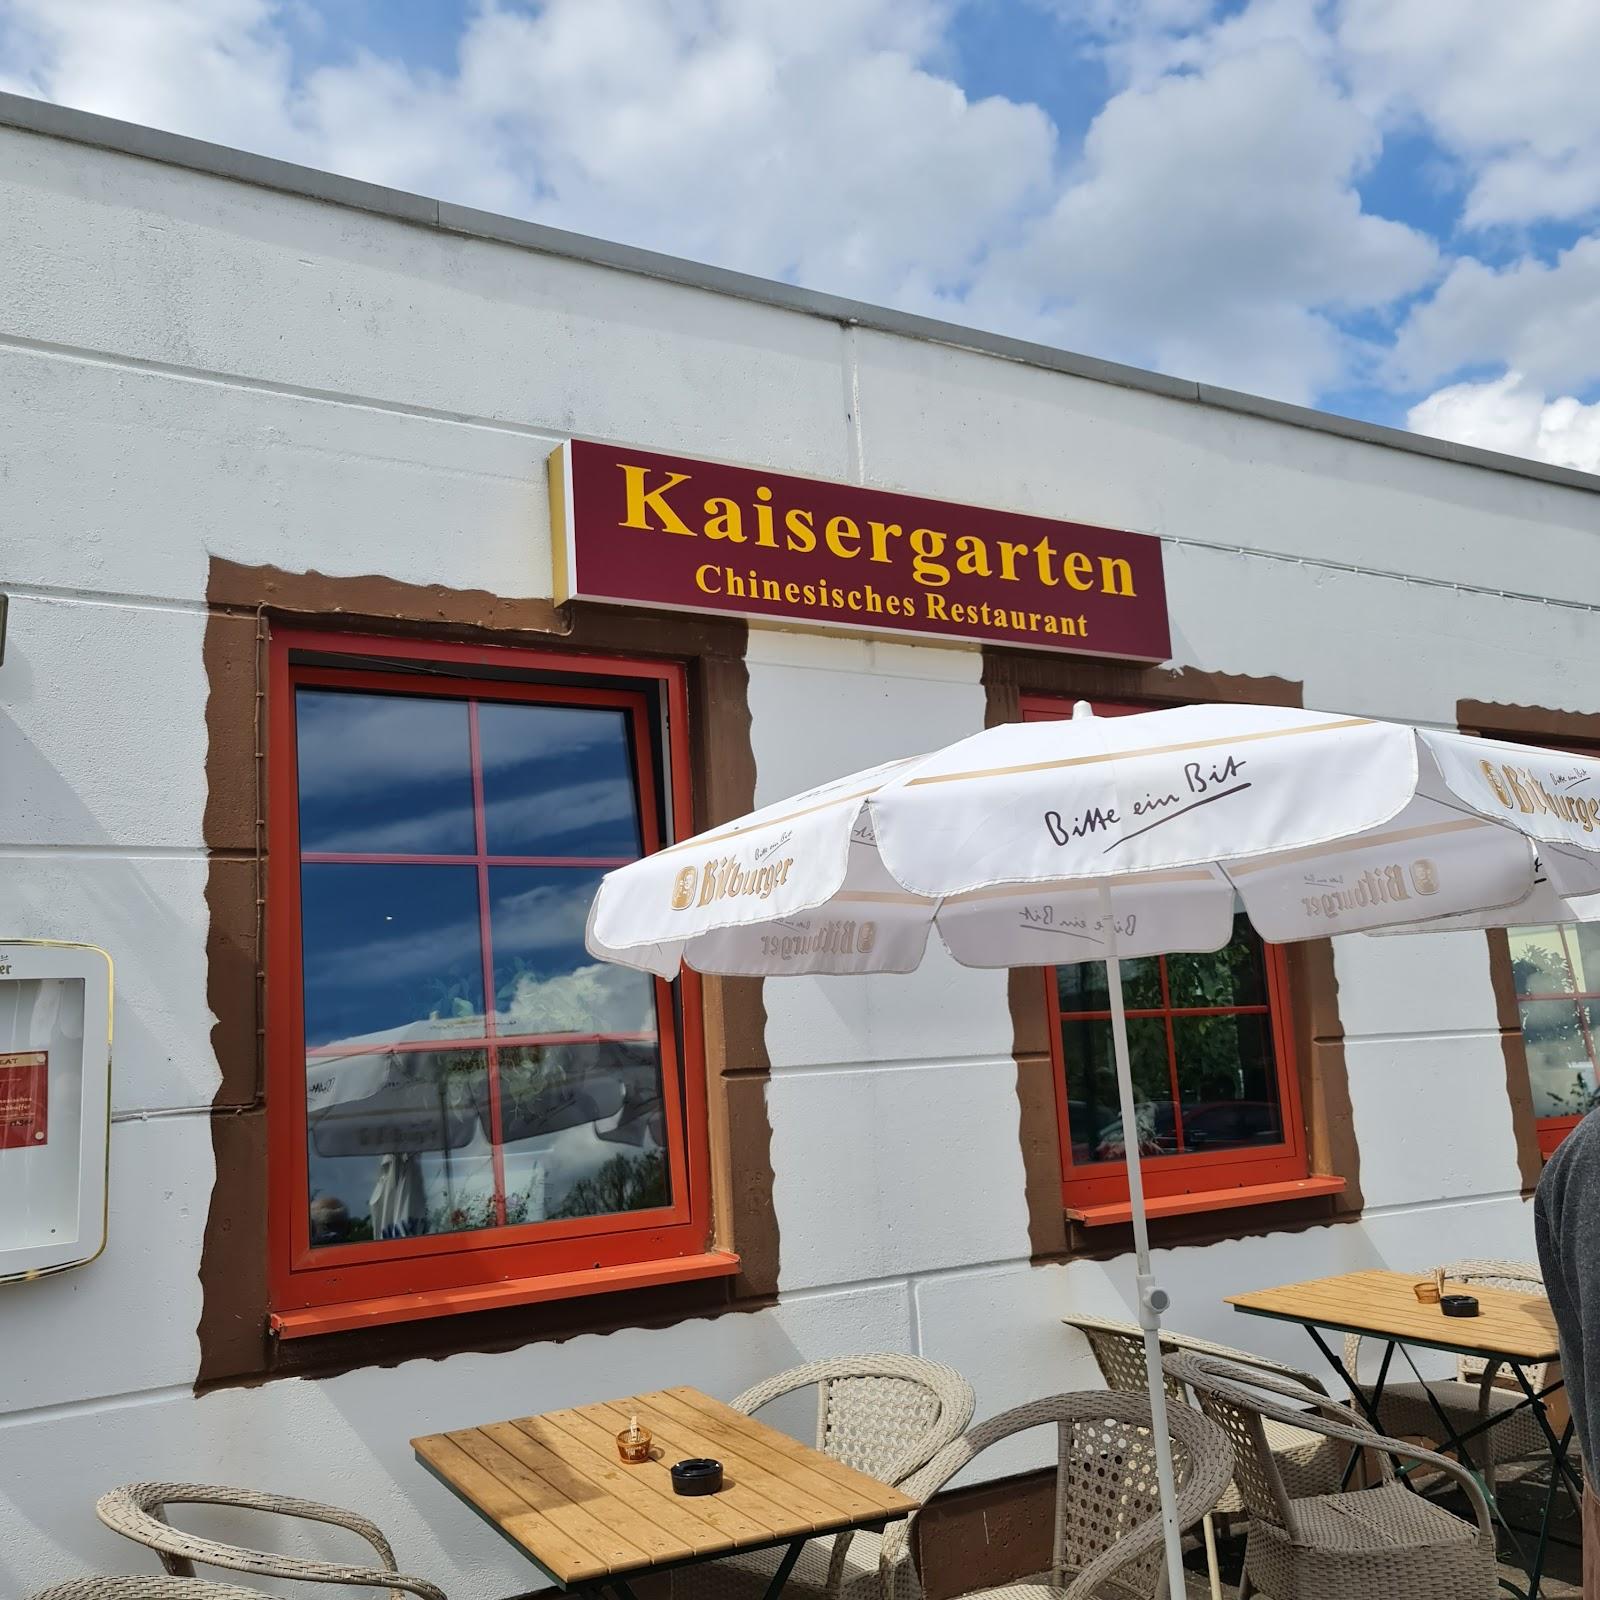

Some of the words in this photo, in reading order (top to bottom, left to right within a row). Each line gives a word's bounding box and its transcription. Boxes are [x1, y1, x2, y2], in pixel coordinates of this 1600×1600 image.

[616, 463, 1137, 598] Kaisergarten
[695, 564, 915, 618] Chinesisches
[925, 592, 1089, 637] Restaurant
[1045, 808, 1120, 846] Bitte
[1133, 793, 1180, 815] ein
[1184, 755, 1246, 792] Bit
[1502, 764, 1600, 832] Bitburge
[696, 854, 794, 908] Bitburger
